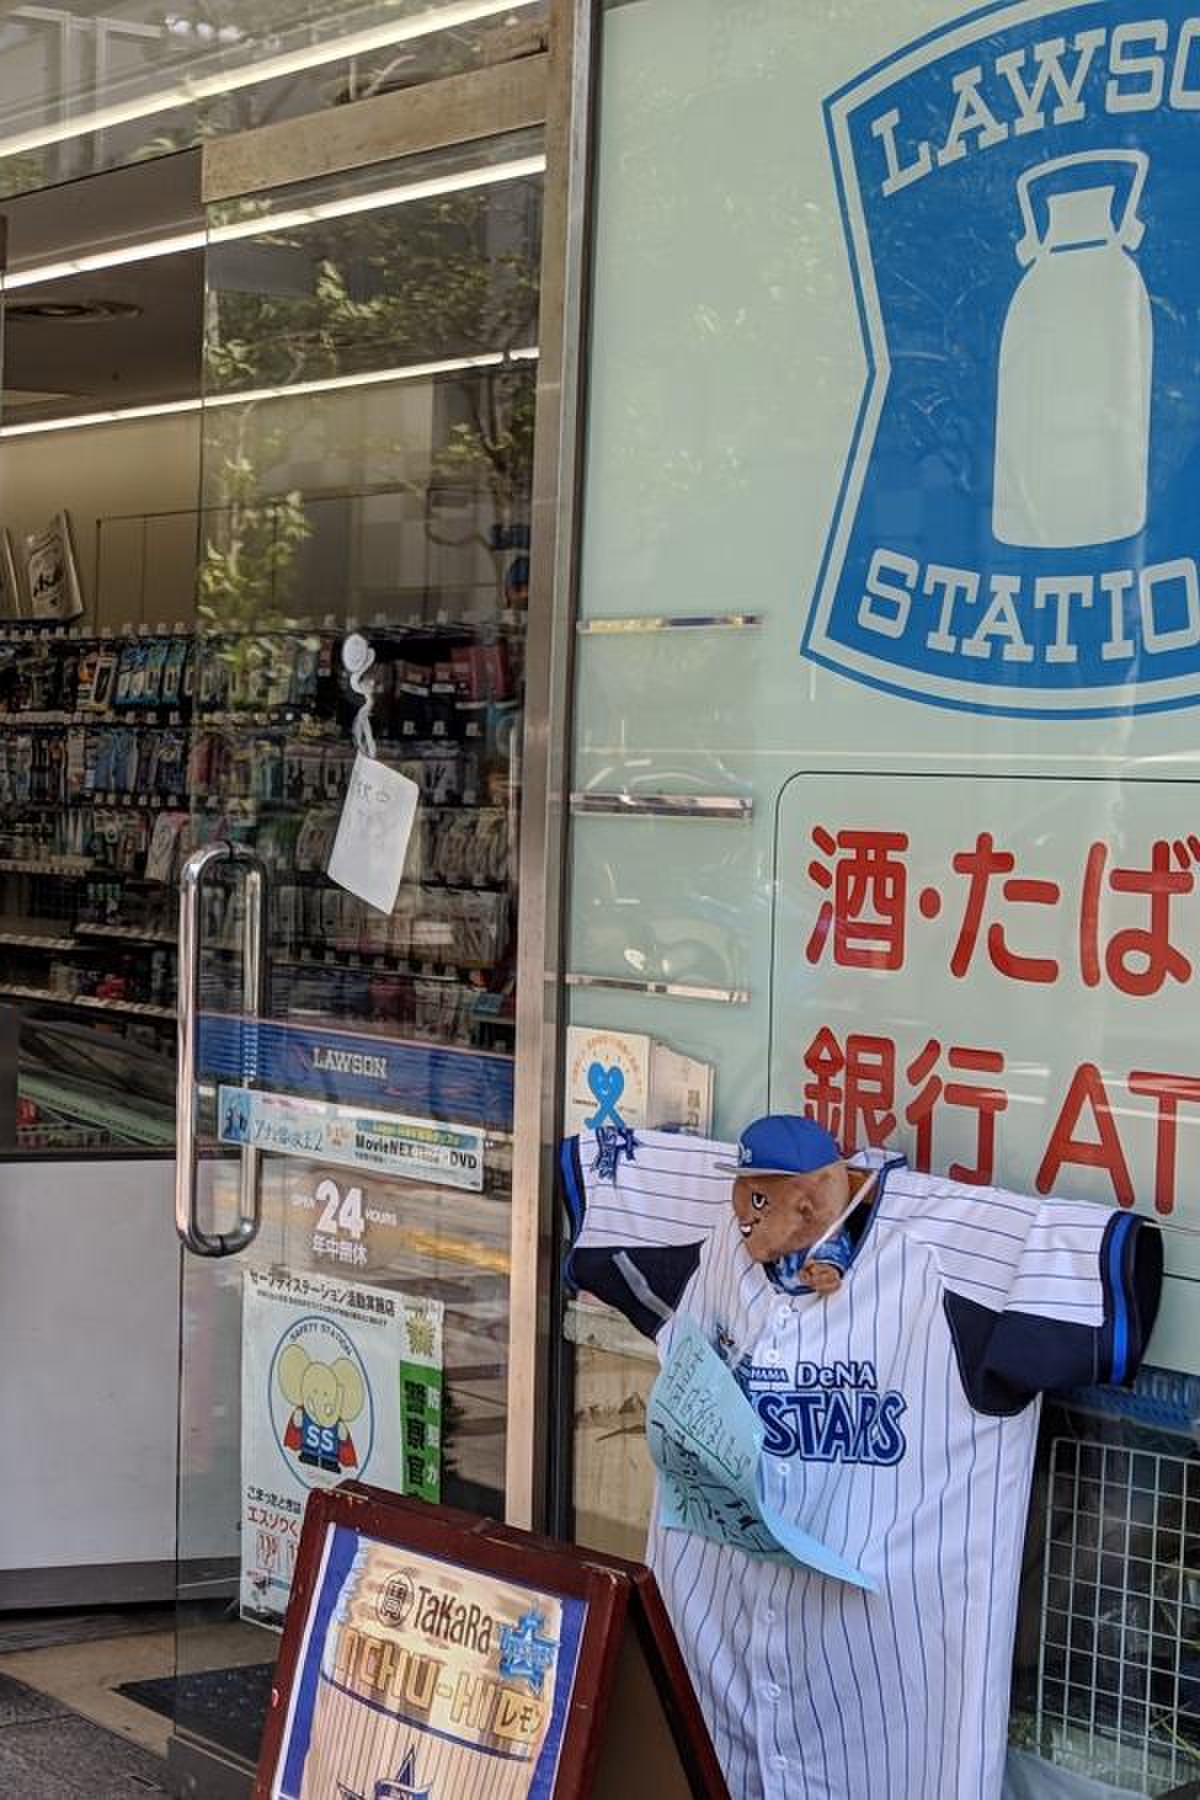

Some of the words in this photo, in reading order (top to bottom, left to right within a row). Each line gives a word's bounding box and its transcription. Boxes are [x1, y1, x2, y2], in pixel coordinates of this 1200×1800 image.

[857, 548, 1200, 663] STATIO
[312, 1047, 388, 1080] LAWSON
[804, 1026, 1008, 1187] 銀行
[1035, 1063, 1200, 1216] AT
[450, 1150, 478, 1170] DVD
[316, 1179, 365, 1239] 24
[794, 1360, 878, 1390] DeNA
[306, 1426, 334, 1453] SS
[755, 1390, 908, 1468] STARS
